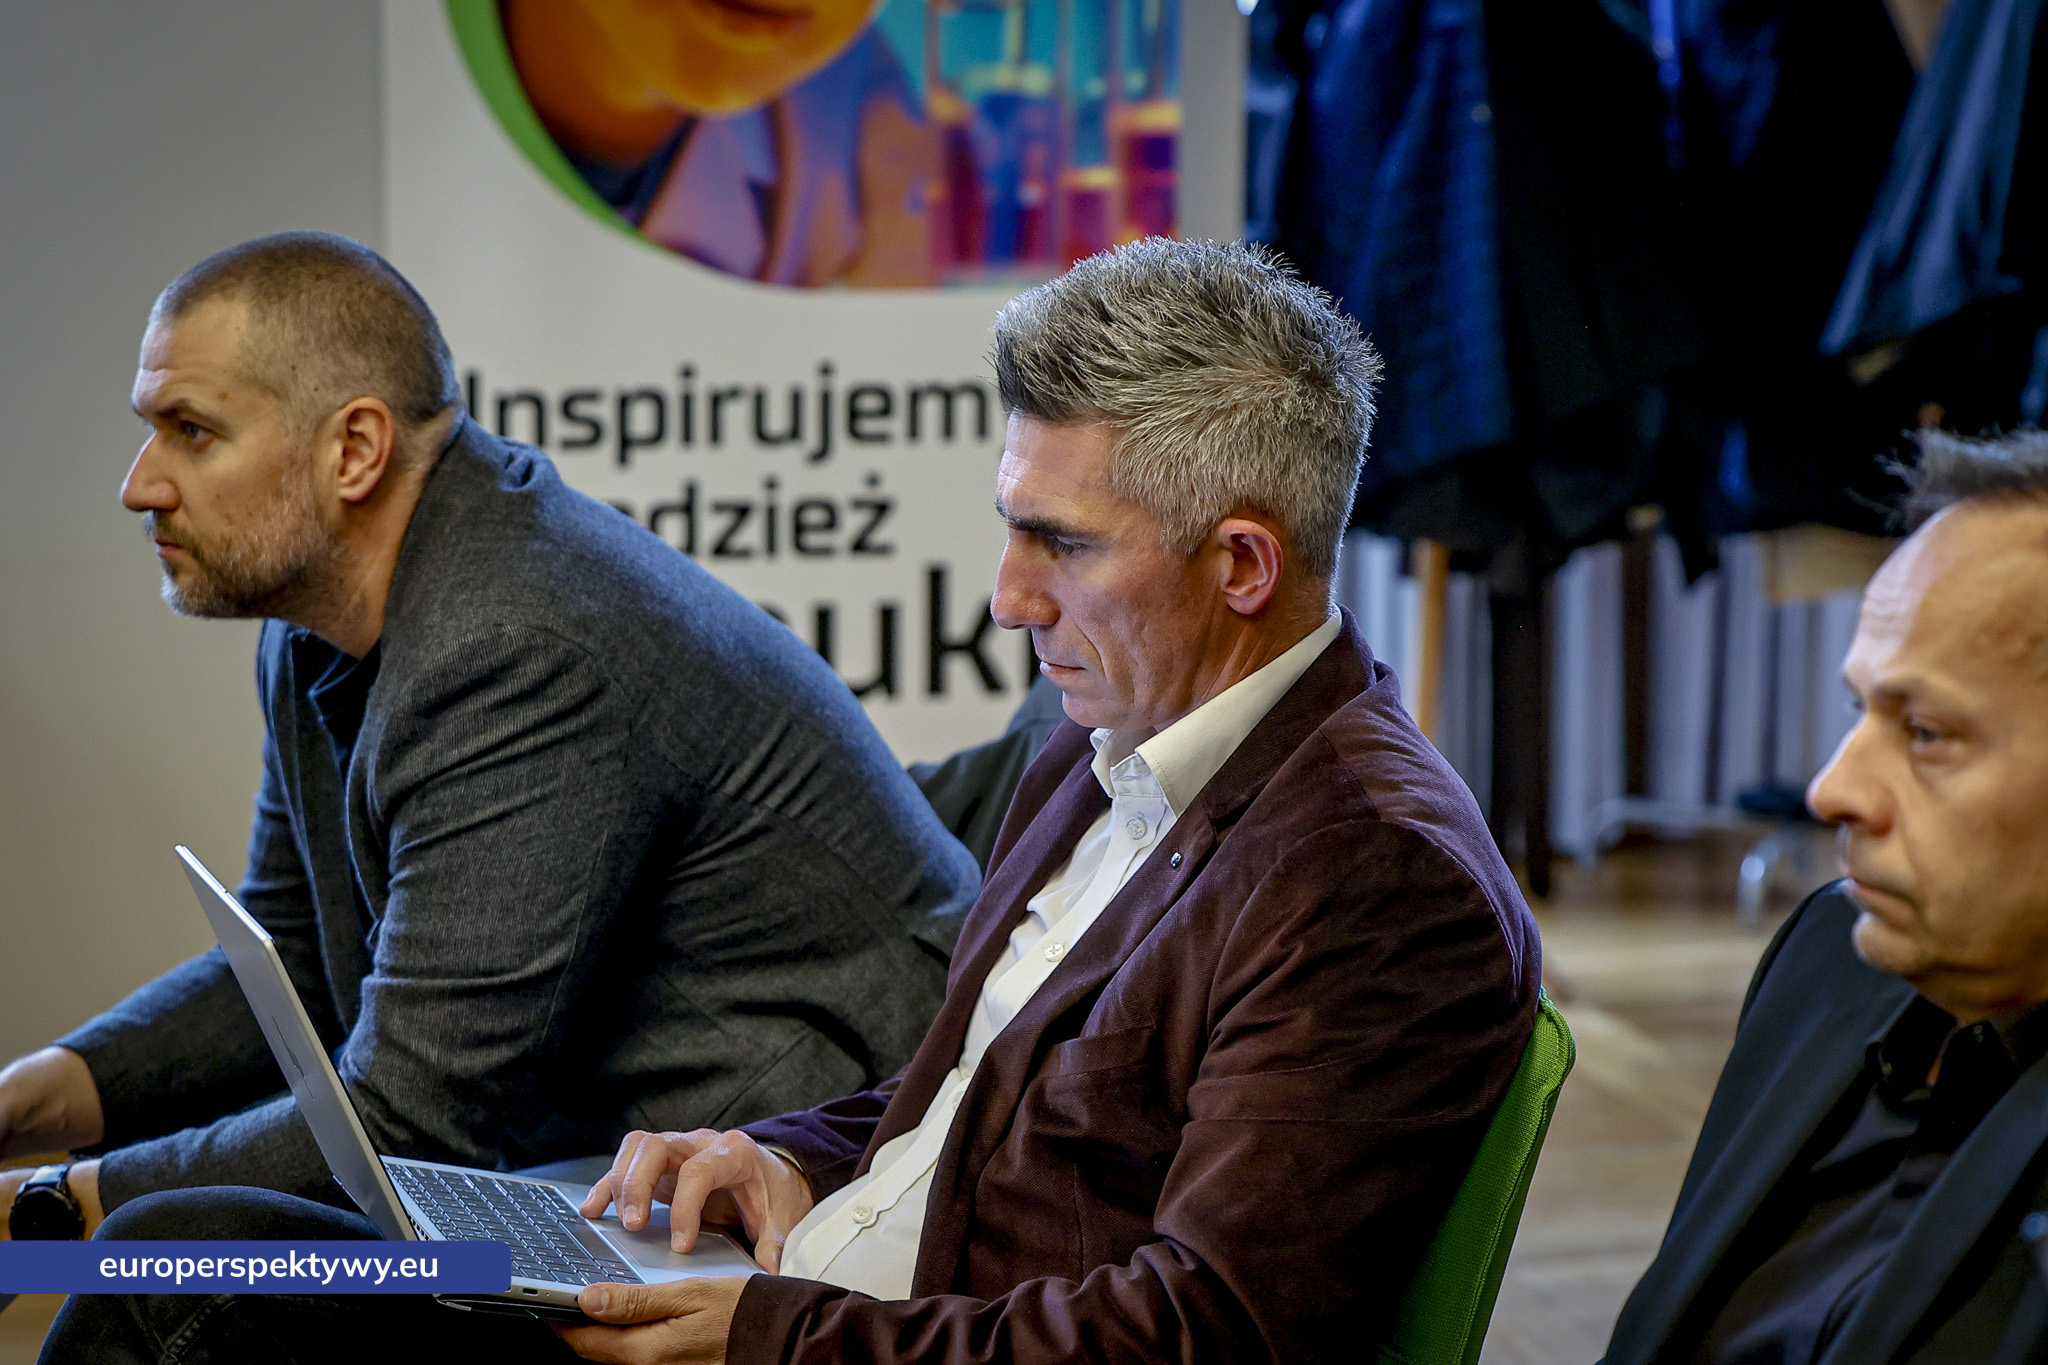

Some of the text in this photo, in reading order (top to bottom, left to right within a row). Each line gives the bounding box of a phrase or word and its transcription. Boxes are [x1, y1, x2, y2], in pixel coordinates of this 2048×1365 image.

[465, 362, 996, 467] Inspirujem
[608, 474, 896, 558] dzież
[758, 562, 1041, 697] uk
